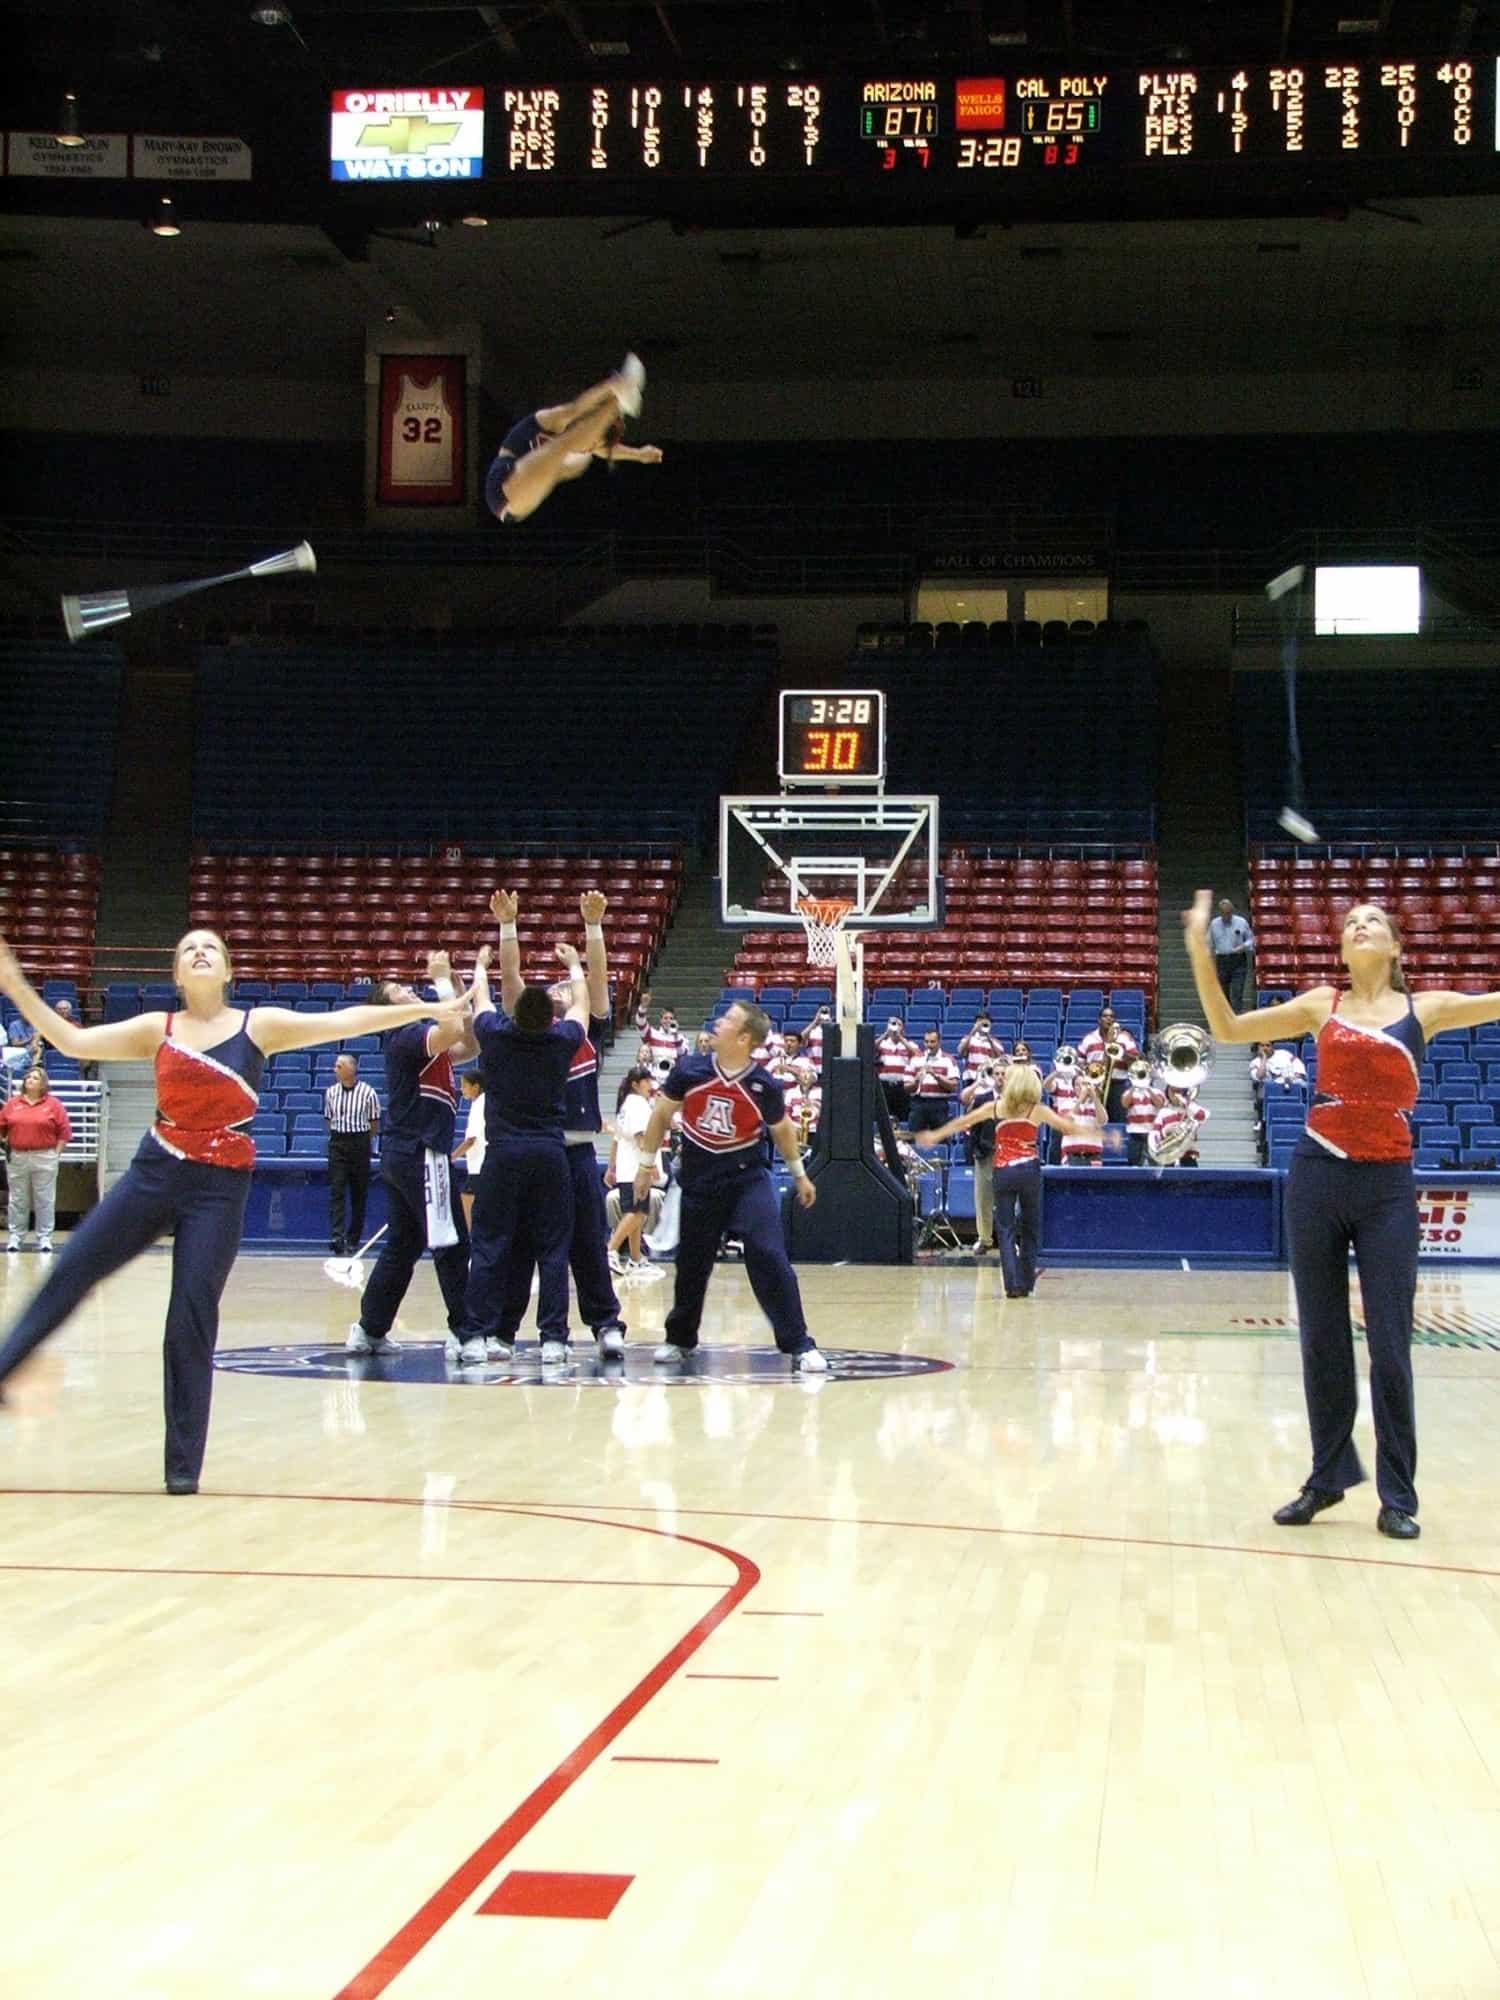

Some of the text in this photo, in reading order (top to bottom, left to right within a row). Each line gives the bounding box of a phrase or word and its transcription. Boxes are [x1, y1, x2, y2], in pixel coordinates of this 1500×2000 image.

[1016, 76, 1107, 98] CAL POLY
[1139, 74, 1197, 96] PLYR
[1269, 68, 1304, 90] 20
[1324, 67, 1360, 88] 22
[1380, 64, 1416, 86] 25
[1436, 62, 1472, 84] 40
[504, 90, 559, 111] PLYR
[787, 85, 820, 106] 20
[863, 82, 936, 102] ARIZONA
[958, 95, 1003, 105] WELLS
[1149, 94, 1190, 115] PTS
[513, 111, 552, 130] PTS
[885, 107, 921, 135] 87
[1046, 103, 1084, 131] 65
[1145, 115, 1193, 136] RBS
[957, 138, 1021, 168] 3:28
[1145, 135, 1193, 156] FLS
[344, 159, 471, 179] WATSON
[509, 150, 555, 171] FLS
[402, 417, 442, 443] 32
[809, 699, 870, 723] 3:28
[804, 732, 859, 769] 30
[928, 980, 941, 990] 21
